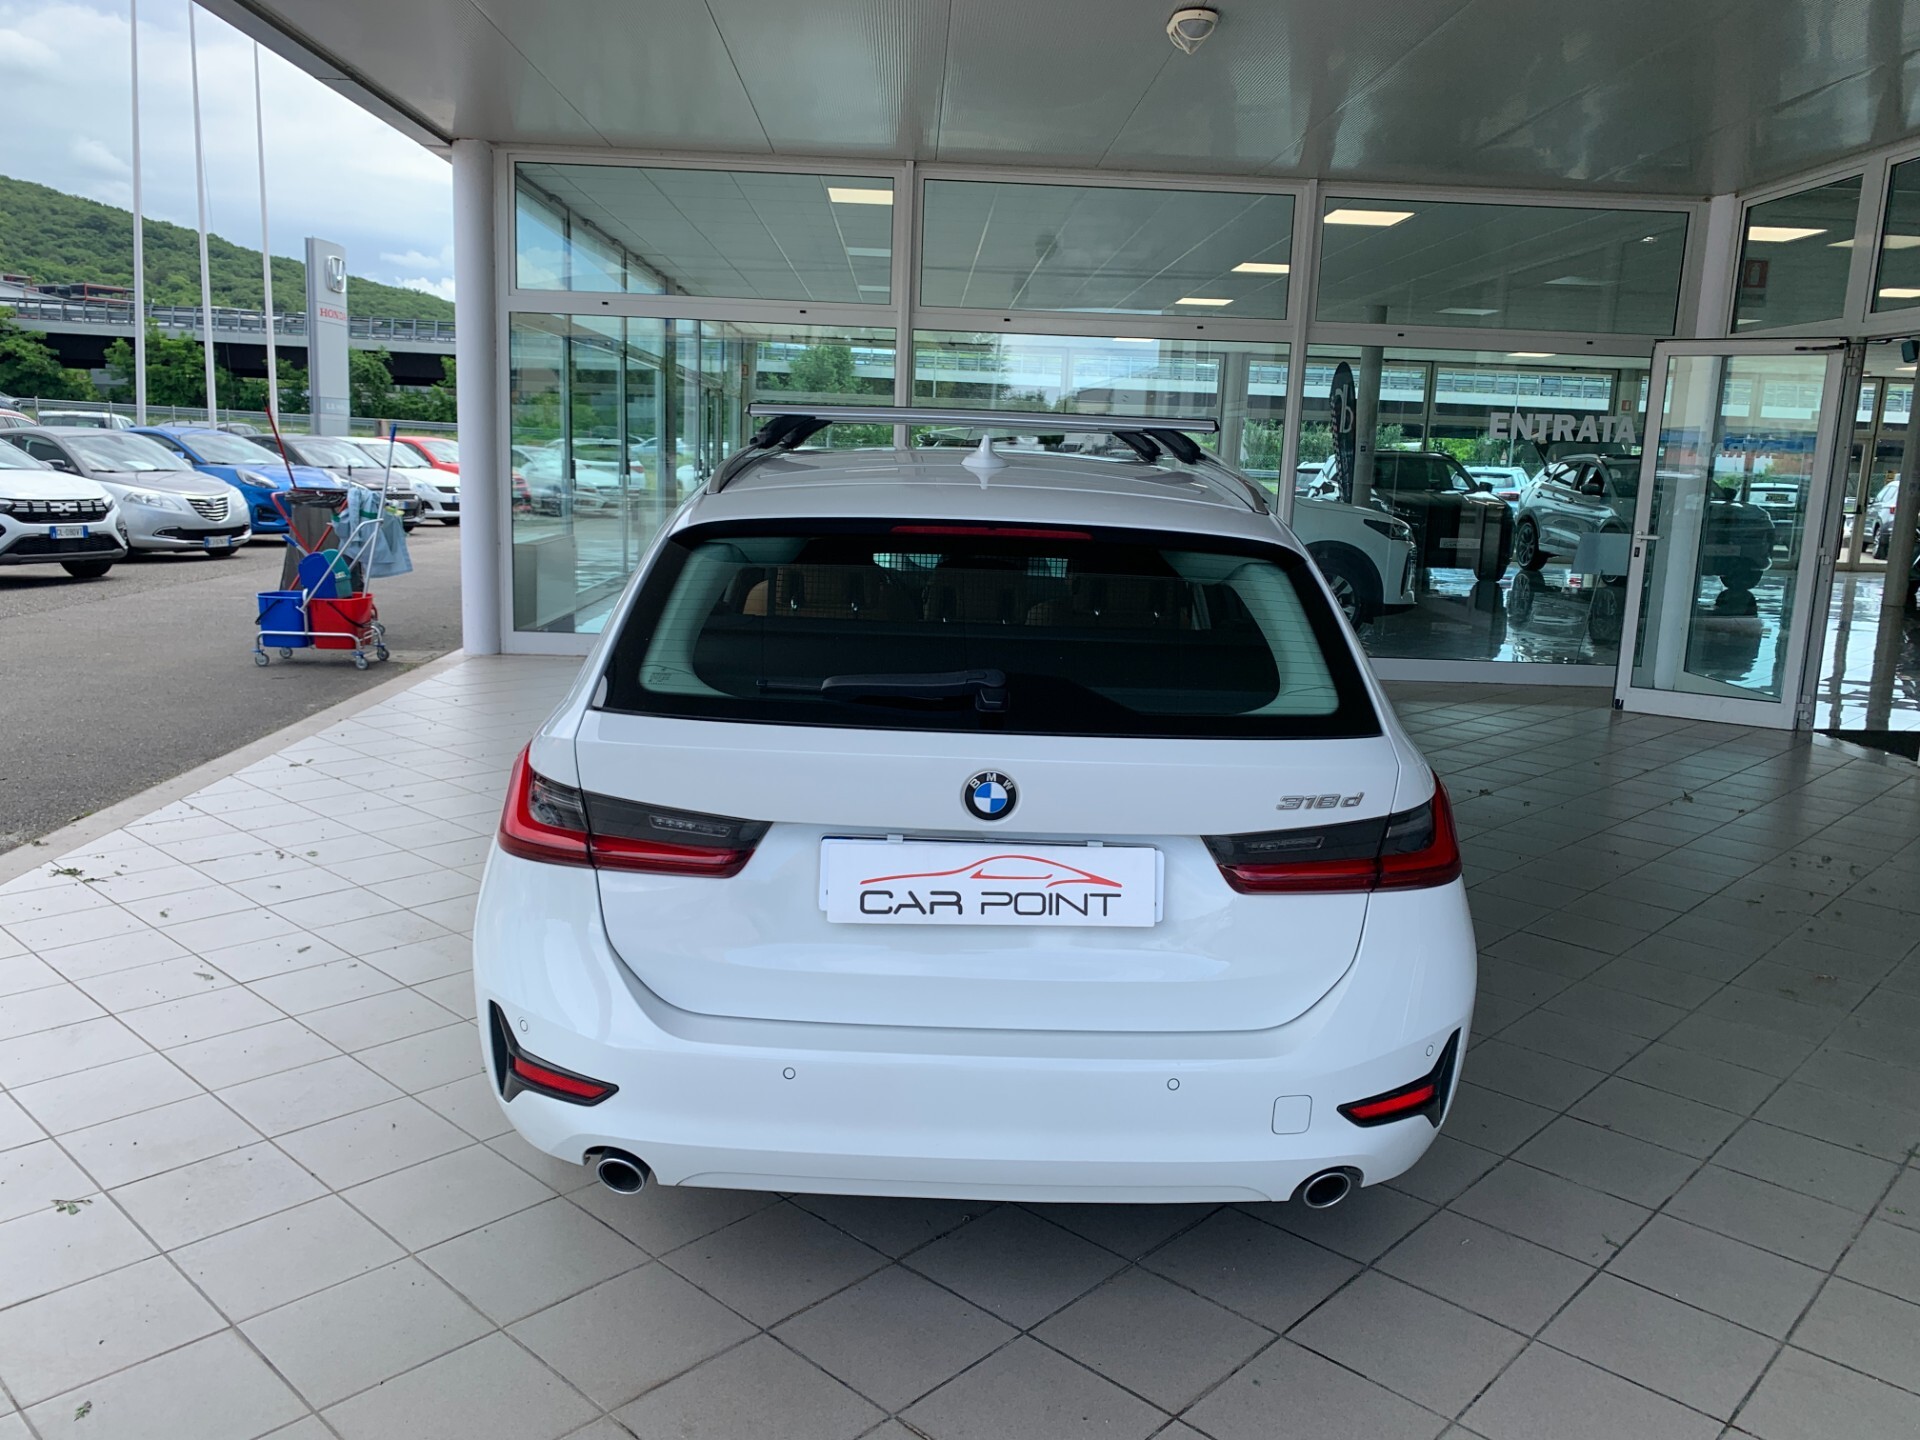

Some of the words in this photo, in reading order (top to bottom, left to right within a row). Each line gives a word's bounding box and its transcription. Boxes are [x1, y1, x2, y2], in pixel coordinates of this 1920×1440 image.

[1489, 412, 1636, 444] ENTRATA
[969, 772, 1014, 790] BMW
[1276, 792, 1365, 810] 318d
[860, 890, 963, 915] CAR
[981, 892, 1121, 916] POINT
